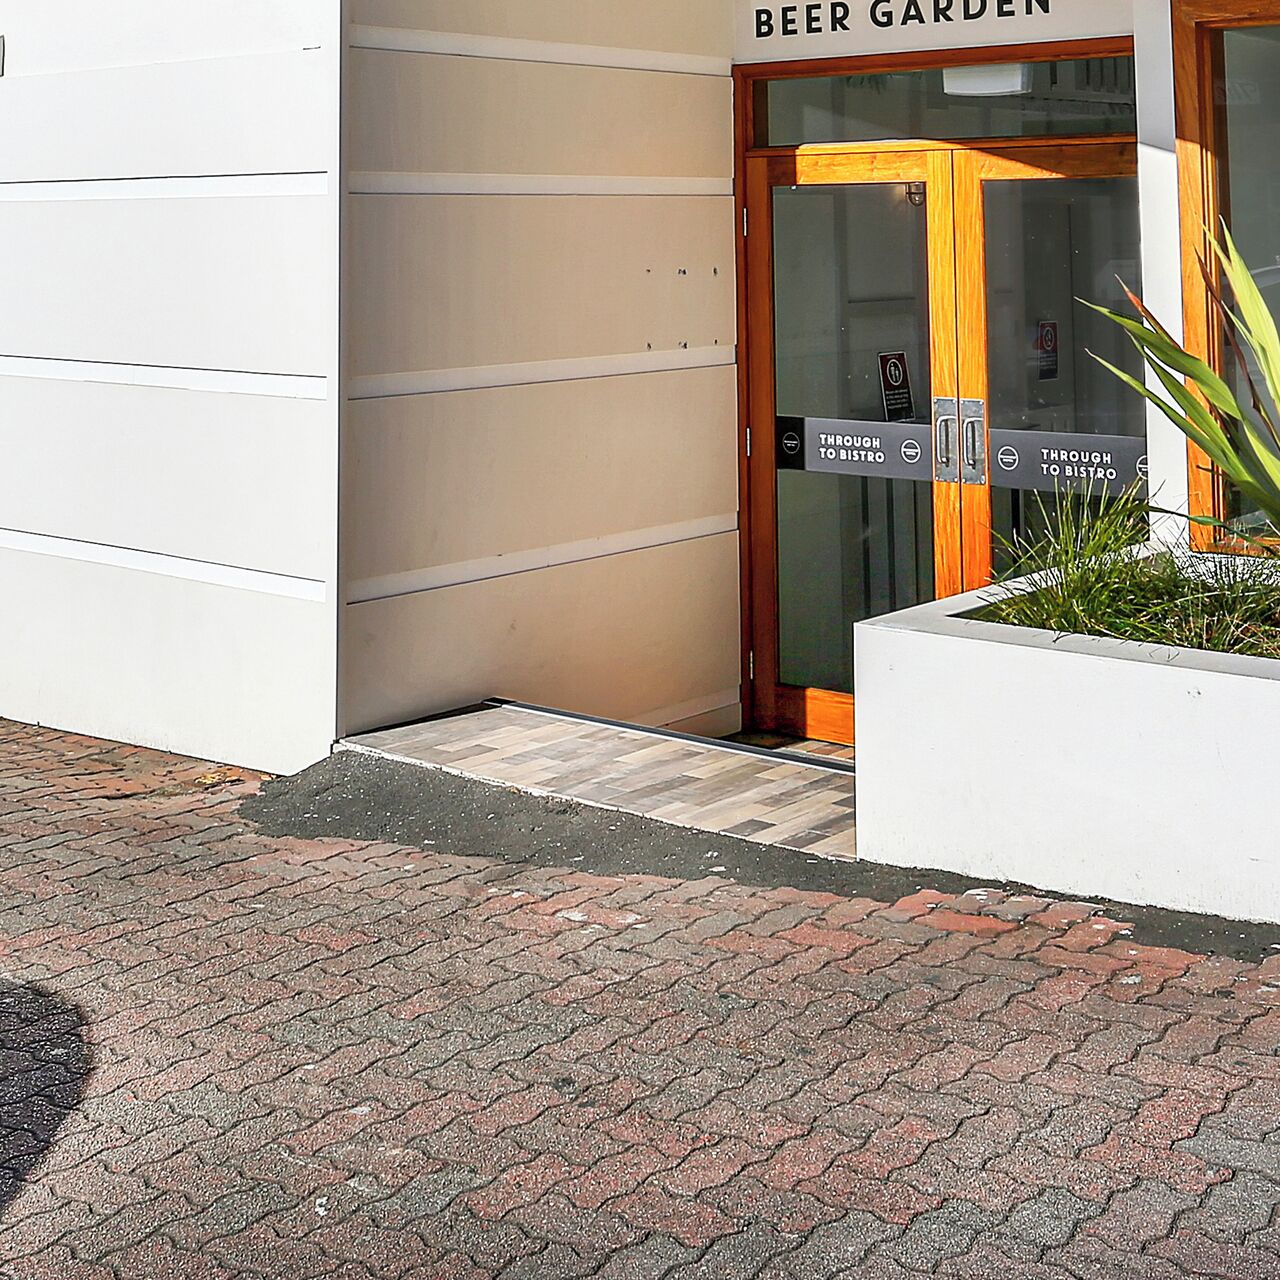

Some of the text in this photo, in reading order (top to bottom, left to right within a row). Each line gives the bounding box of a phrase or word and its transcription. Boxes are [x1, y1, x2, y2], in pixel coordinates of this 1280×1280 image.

[754, 1, 850, 38] BEER
[818, 433, 881, 449] THROUGH
[818, 448, 885, 463] TO BISTRO
[1041, 448, 1112, 465] THROUGH
[1041, 463, 1117, 480] TO BISTRO
